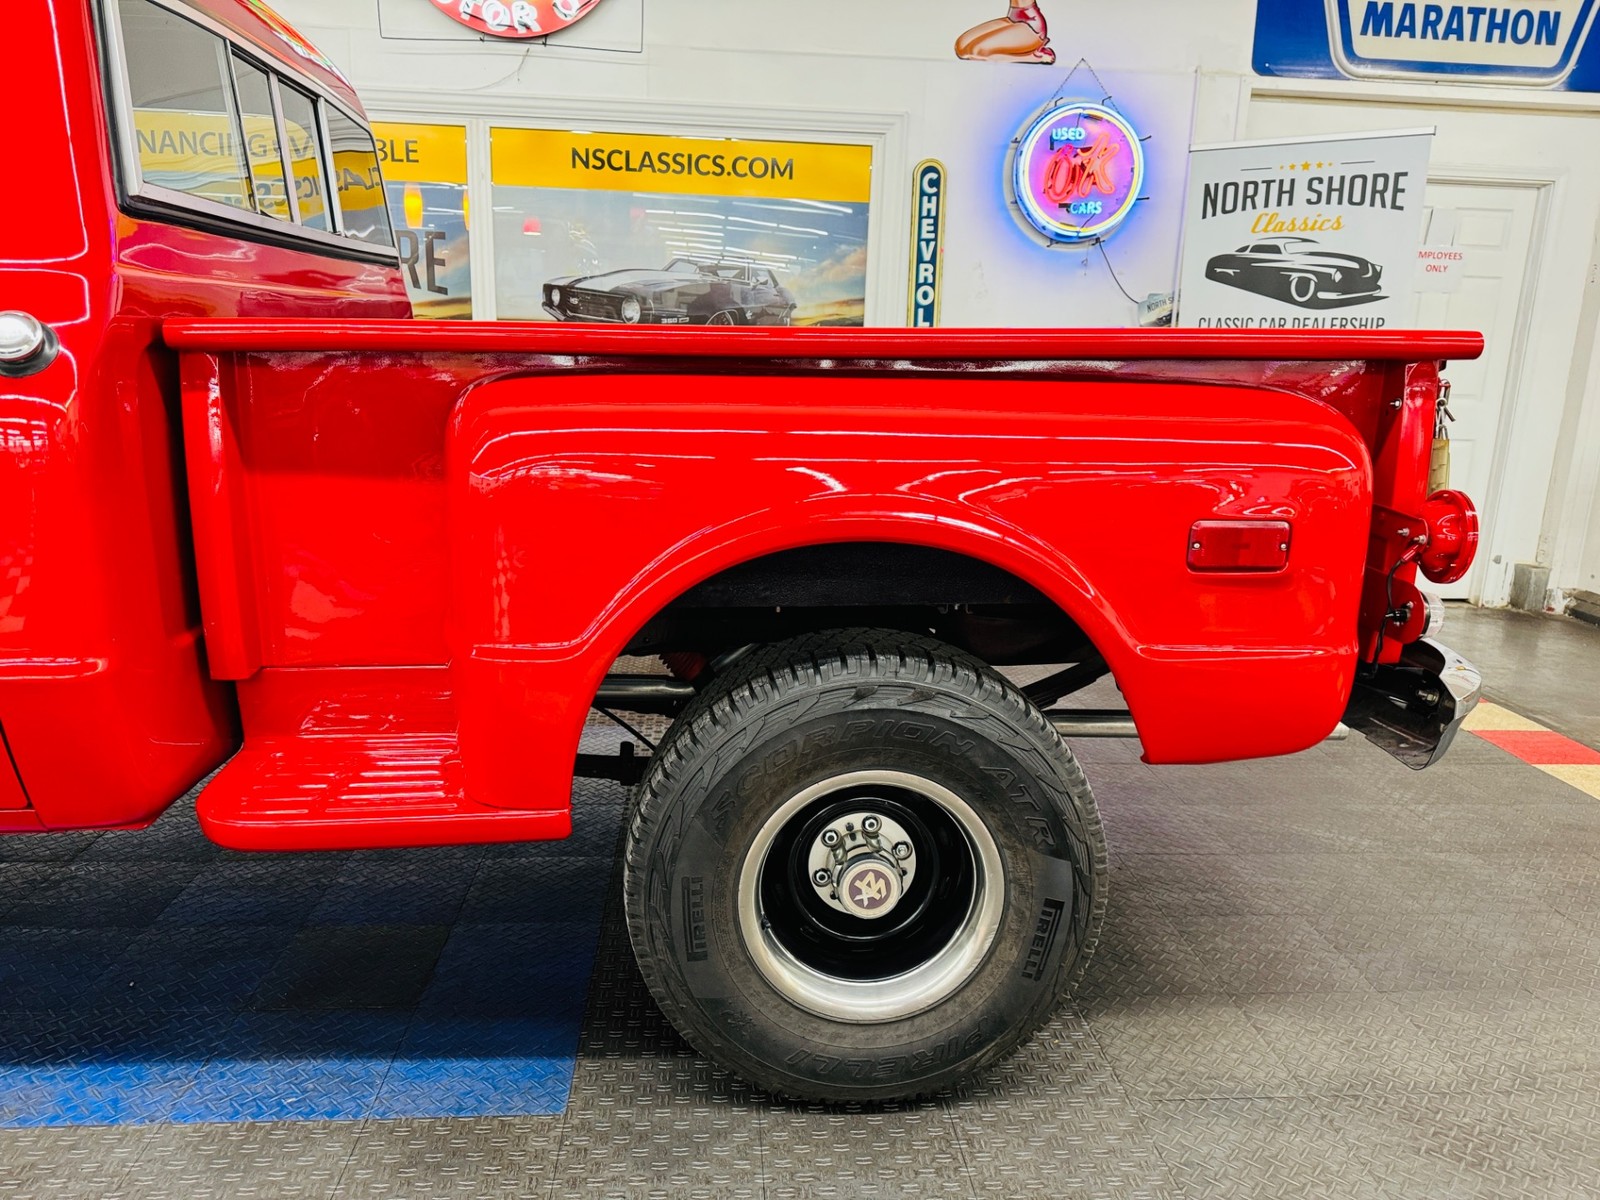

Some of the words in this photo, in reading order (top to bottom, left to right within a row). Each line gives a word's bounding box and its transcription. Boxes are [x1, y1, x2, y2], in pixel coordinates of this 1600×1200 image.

[1360, 1, 1561, 46] MARATHON
[1052, 127, 1086, 140] USED
[571, 147, 794, 180] NSCLASSICS.COM
[1044, 132, 1120, 204] OK
[1070, 201, 1103, 214] CARS
[1202, 178, 1295, 219] NORTH
[1306, 172, 1409, 211] SHORE
[1251, 211, 1345, 234] Classics
[916, 172, 939, 327] CHEVROL
[1418, 251, 1463, 261] MPLOYEES
[1425, 264, 1448, 272] ONLY
[711, 718, 977, 831] SCORPION
[681, 876, 708, 962] PIRELLI
[1021, 897, 1066, 982] PIRELLI
[785, 1016, 989, 1078] PIRELLI
